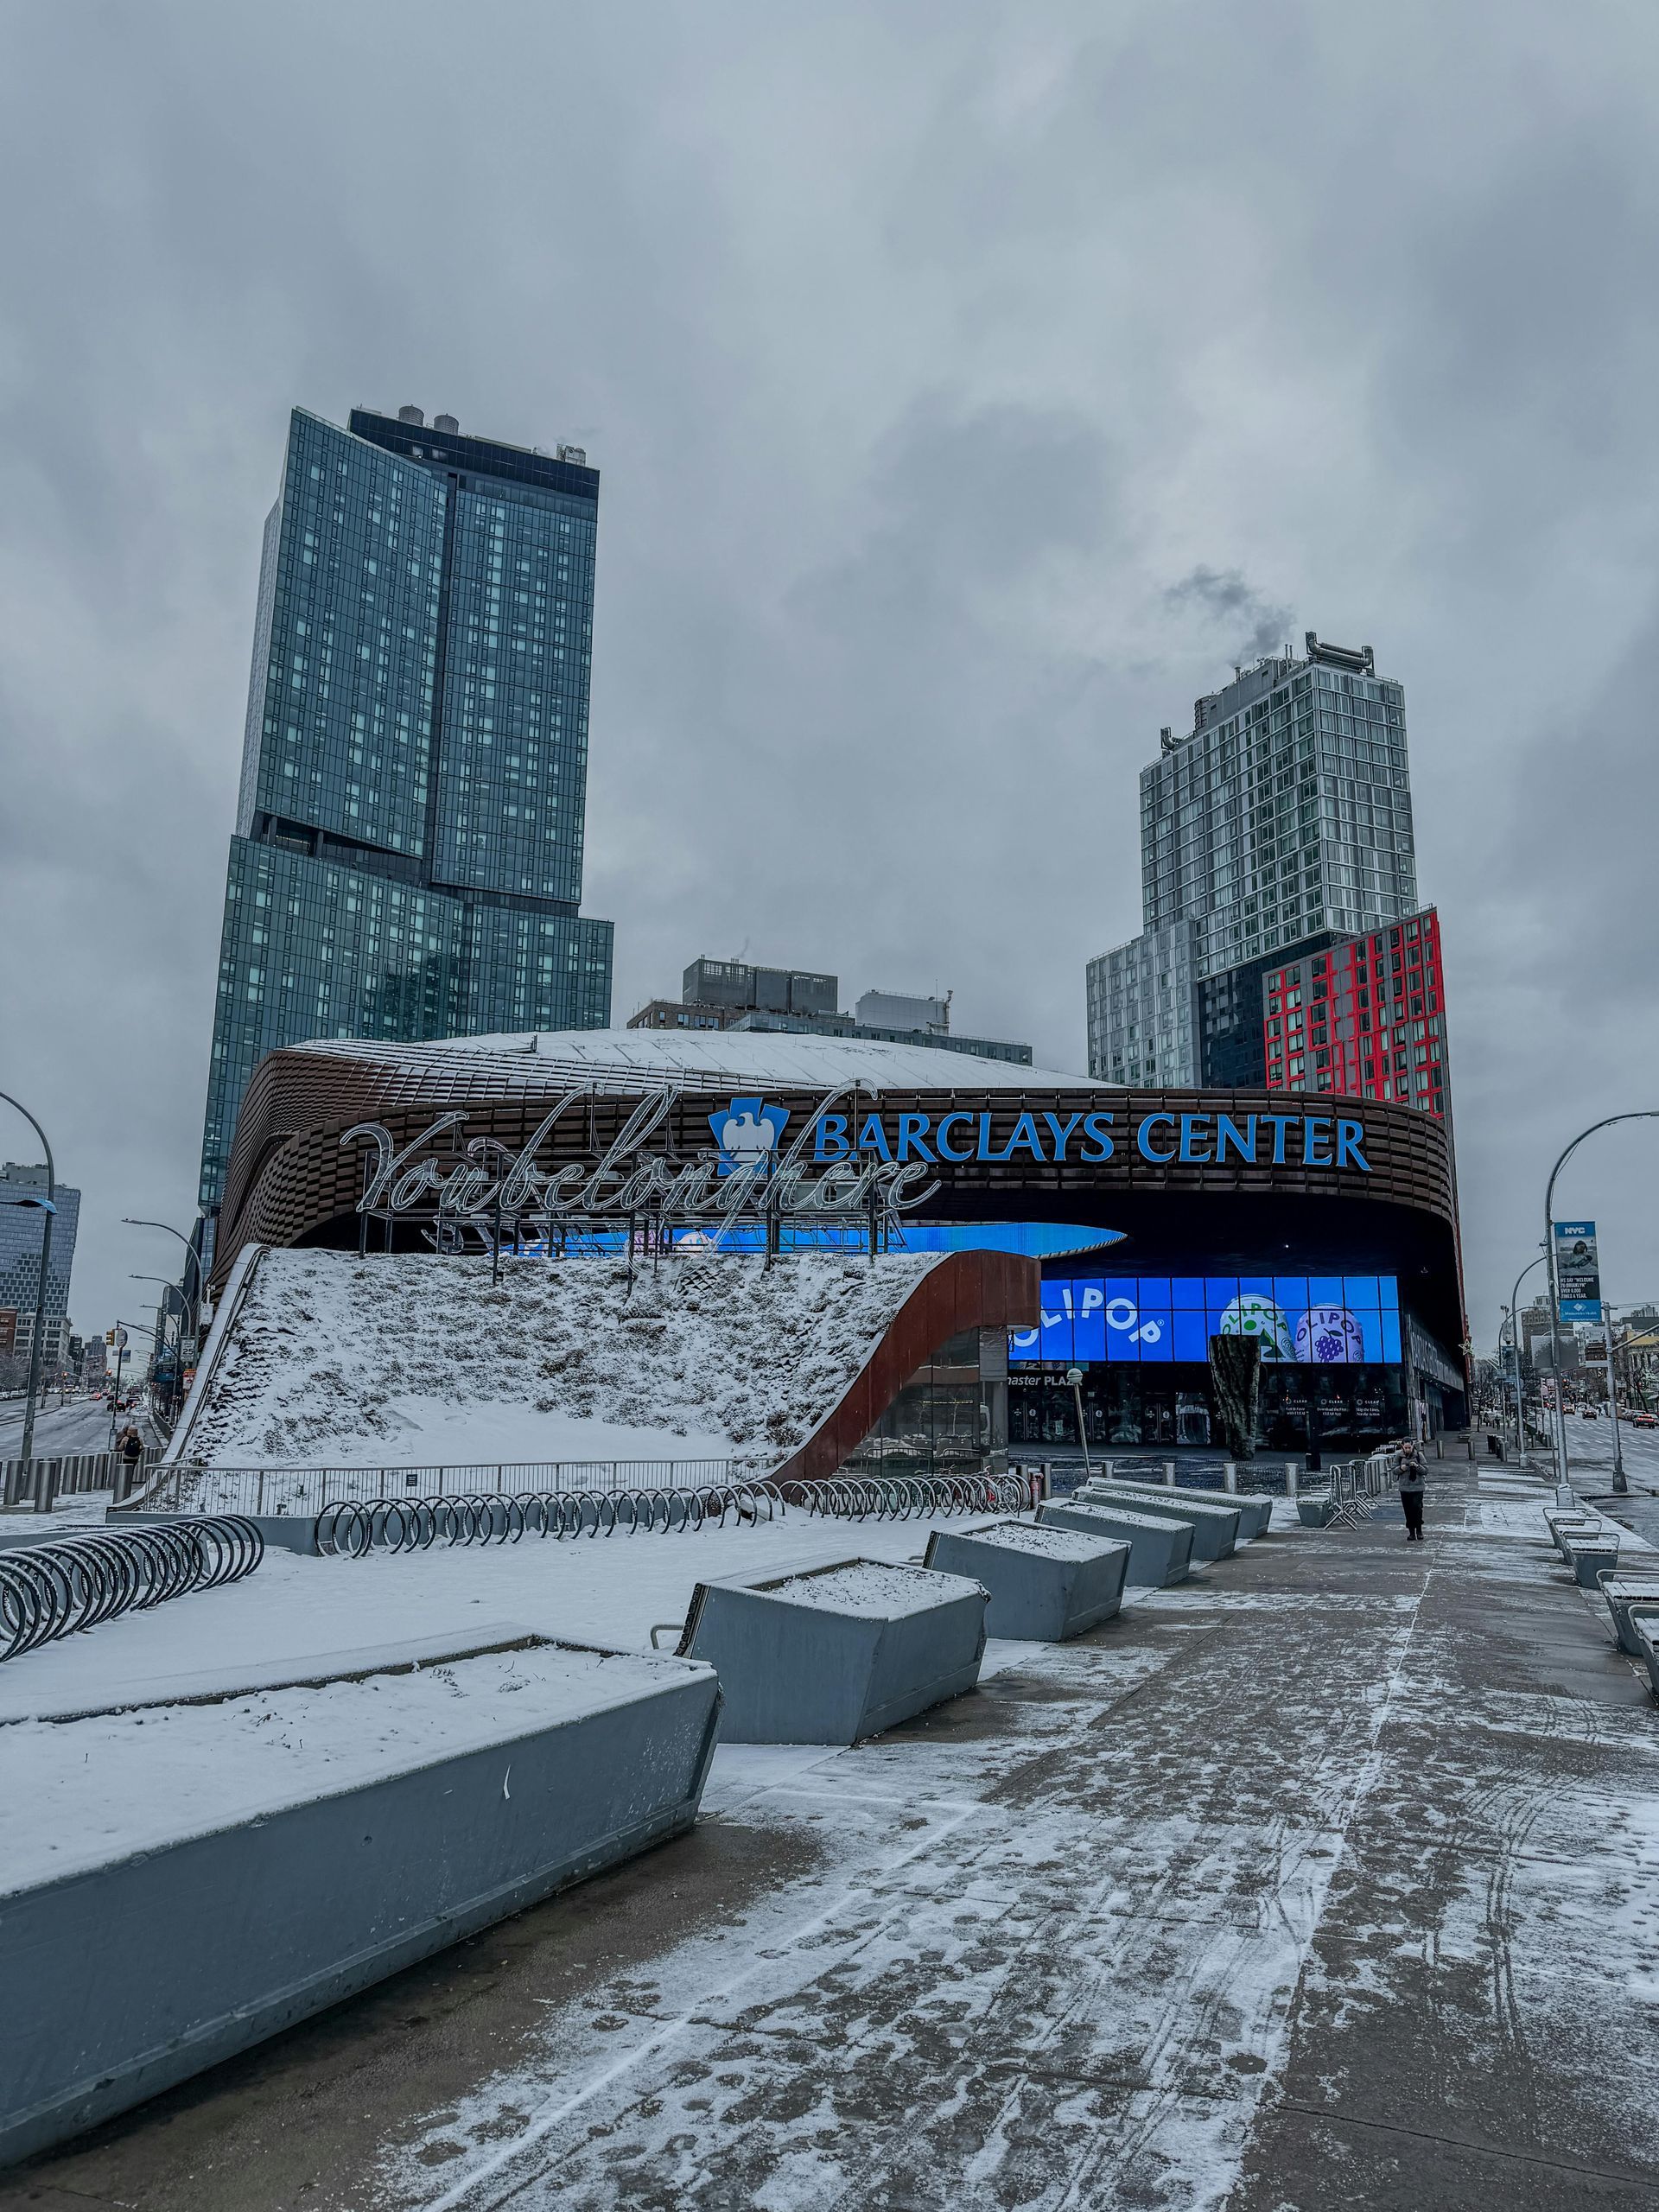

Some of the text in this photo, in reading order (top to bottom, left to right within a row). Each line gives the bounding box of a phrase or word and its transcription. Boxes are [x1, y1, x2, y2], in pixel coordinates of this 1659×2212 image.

[758, 1077, 942, 1211] here
[813, 1111, 1374, 1172] BARCLAYS CENTER
[1223, 1302, 1287, 1335] OLIPOP
[1297, 1312, 1362, 1344] OLIPOP
